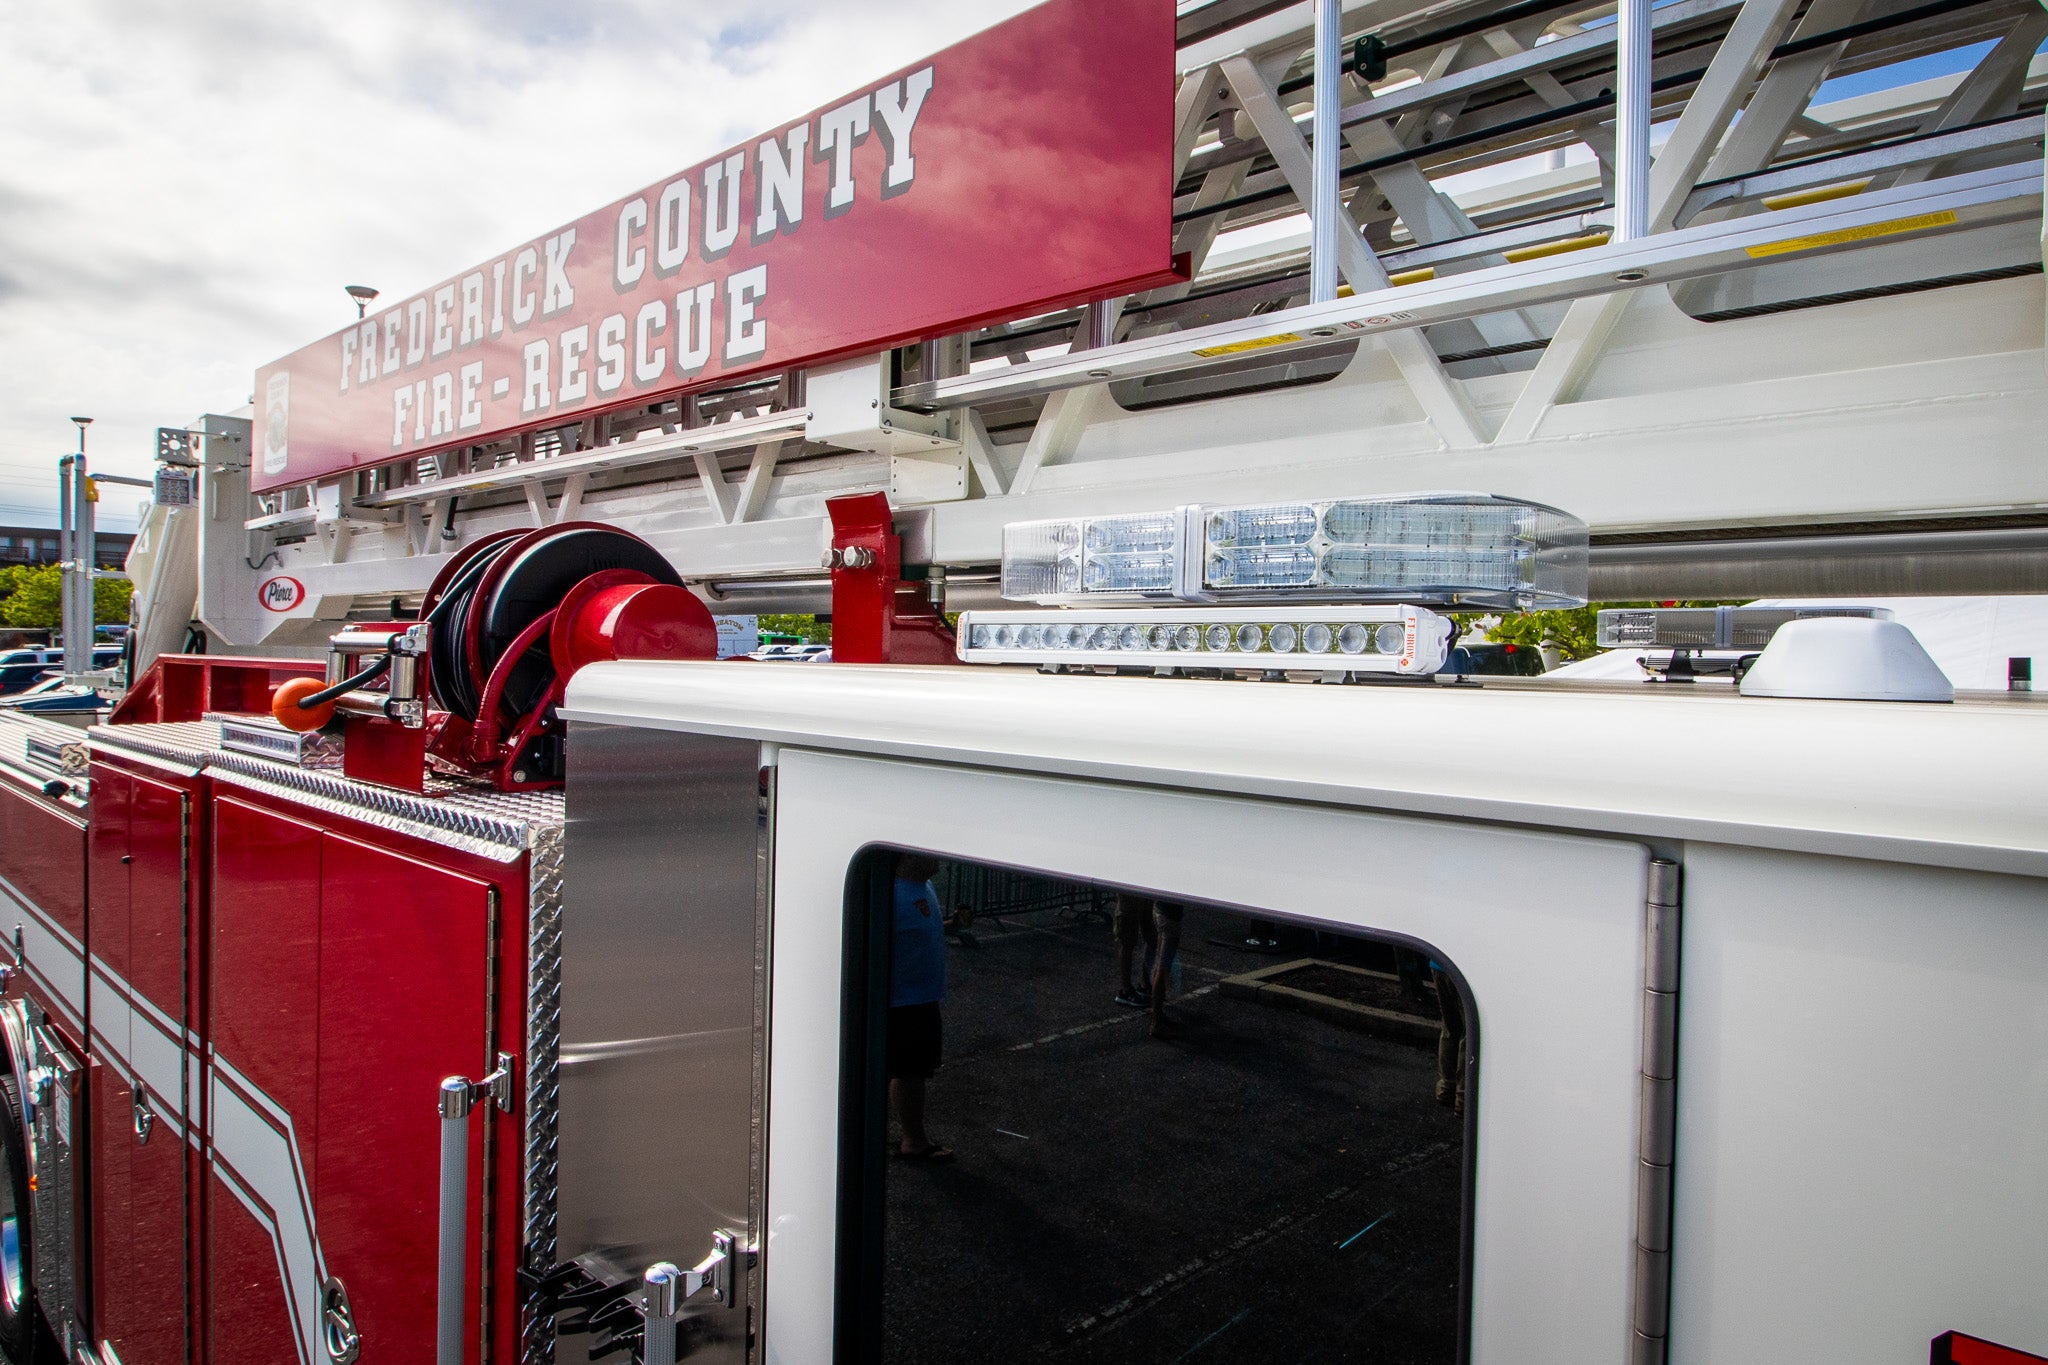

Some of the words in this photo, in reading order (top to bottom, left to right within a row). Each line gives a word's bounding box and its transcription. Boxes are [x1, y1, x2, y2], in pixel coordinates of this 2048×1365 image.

[339, 227, 577, 393] FREDERICK
[614, 64, 935, 291] COUNTY
[268, 582, 293, 605] Pierce
[717, 620, 743, 631] HEATON
